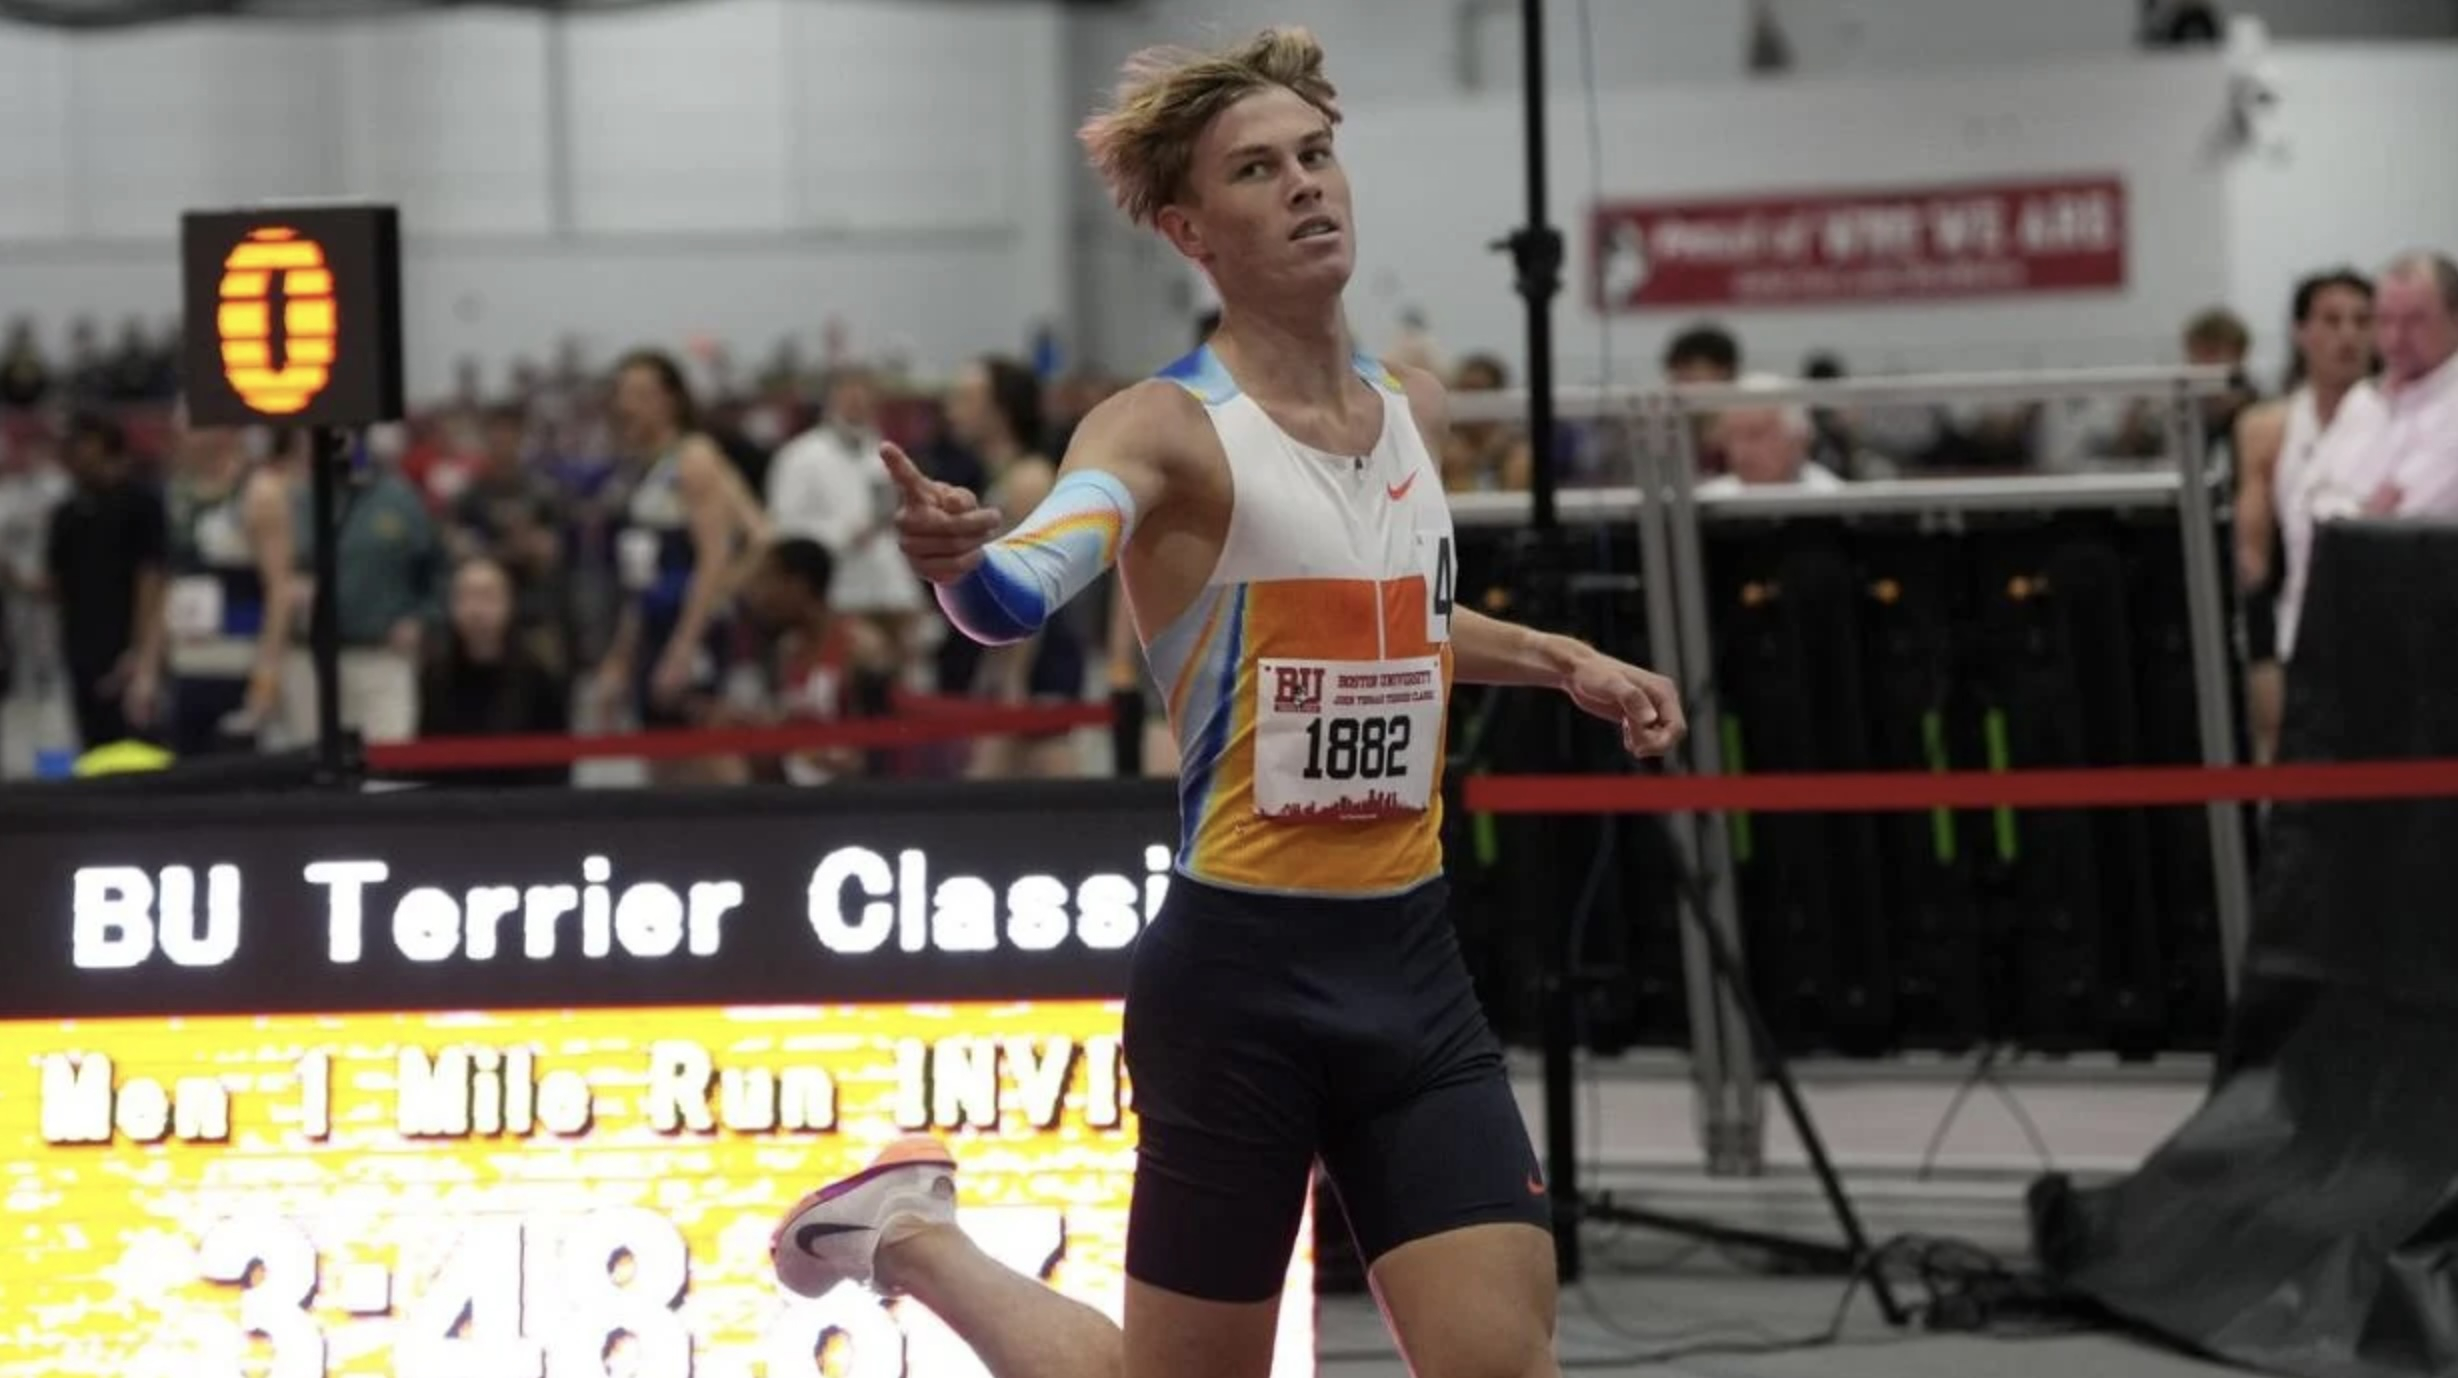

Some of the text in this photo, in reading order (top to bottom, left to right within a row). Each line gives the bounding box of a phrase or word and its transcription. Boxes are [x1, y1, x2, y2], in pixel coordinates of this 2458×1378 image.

[218, 227, 338, 415] 0
[1275, 668, 1325, 702] BU
[1303, 716, 1411, 779] 1882
[73, 863, 241, 968] BU
[303, 855, 742, 963] Terrier
[41, 1050, 231, 1145] Men
[397, 1043, 593, 1140] Mile
[646, 1038, 838, 1135] Run
